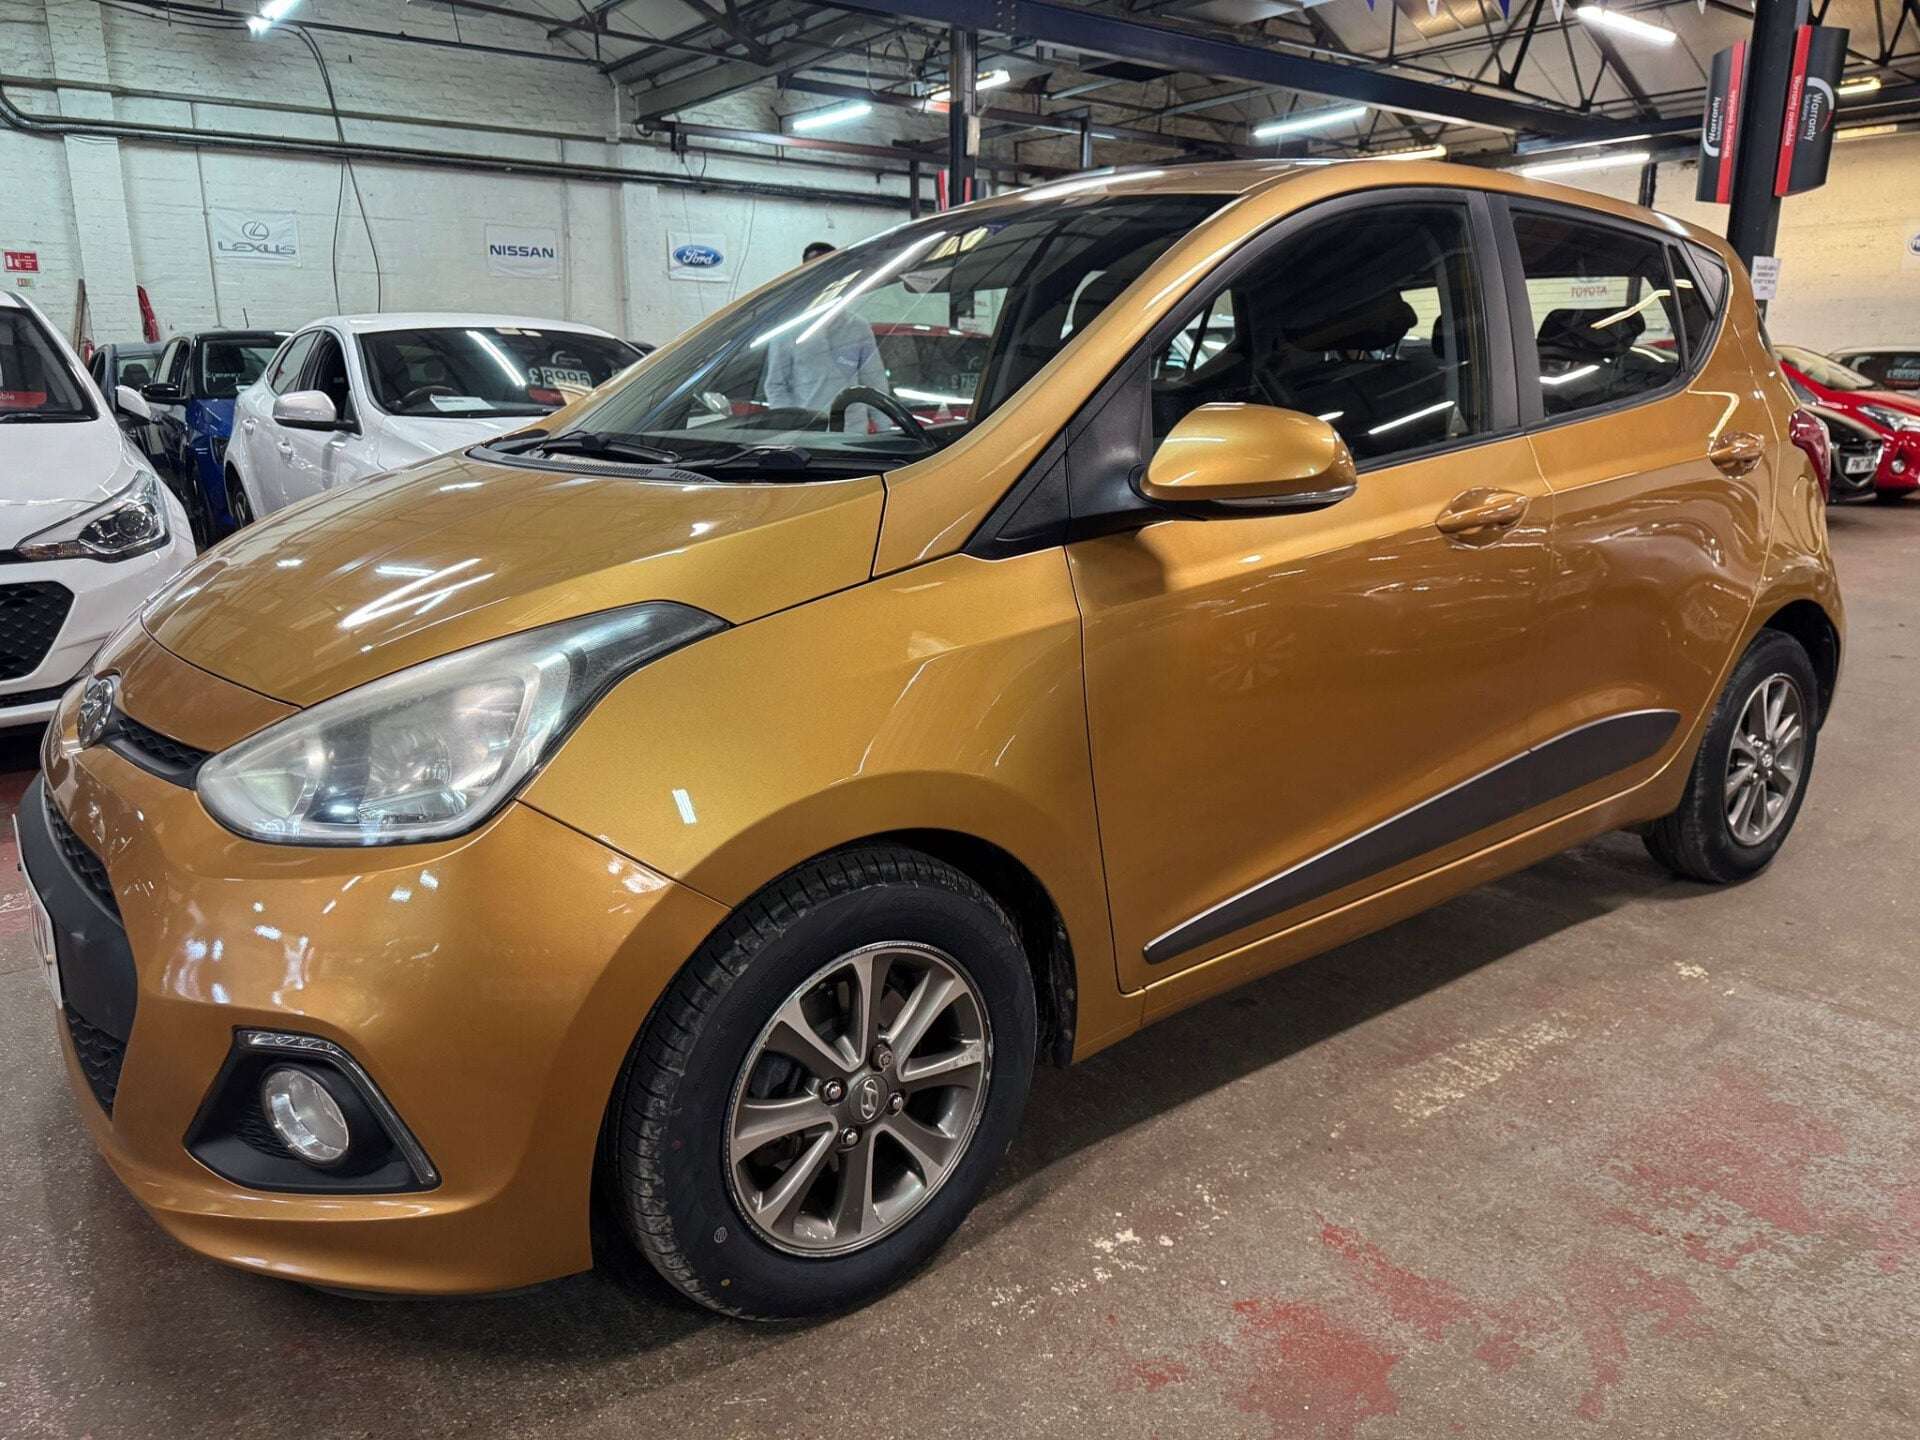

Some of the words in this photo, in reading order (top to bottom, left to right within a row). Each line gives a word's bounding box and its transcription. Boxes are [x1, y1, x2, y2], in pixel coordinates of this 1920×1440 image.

[1708, 97, 1721, 143] Warranty
[1804, 92, 1823, 142] Warranty
[217, 241, 297, 255] LEXUS
[489, 244, 555, 258] NISSAN
[682, 248, 715, 265] Ford
[1571, 286, 1608, 298] TOYOTA
